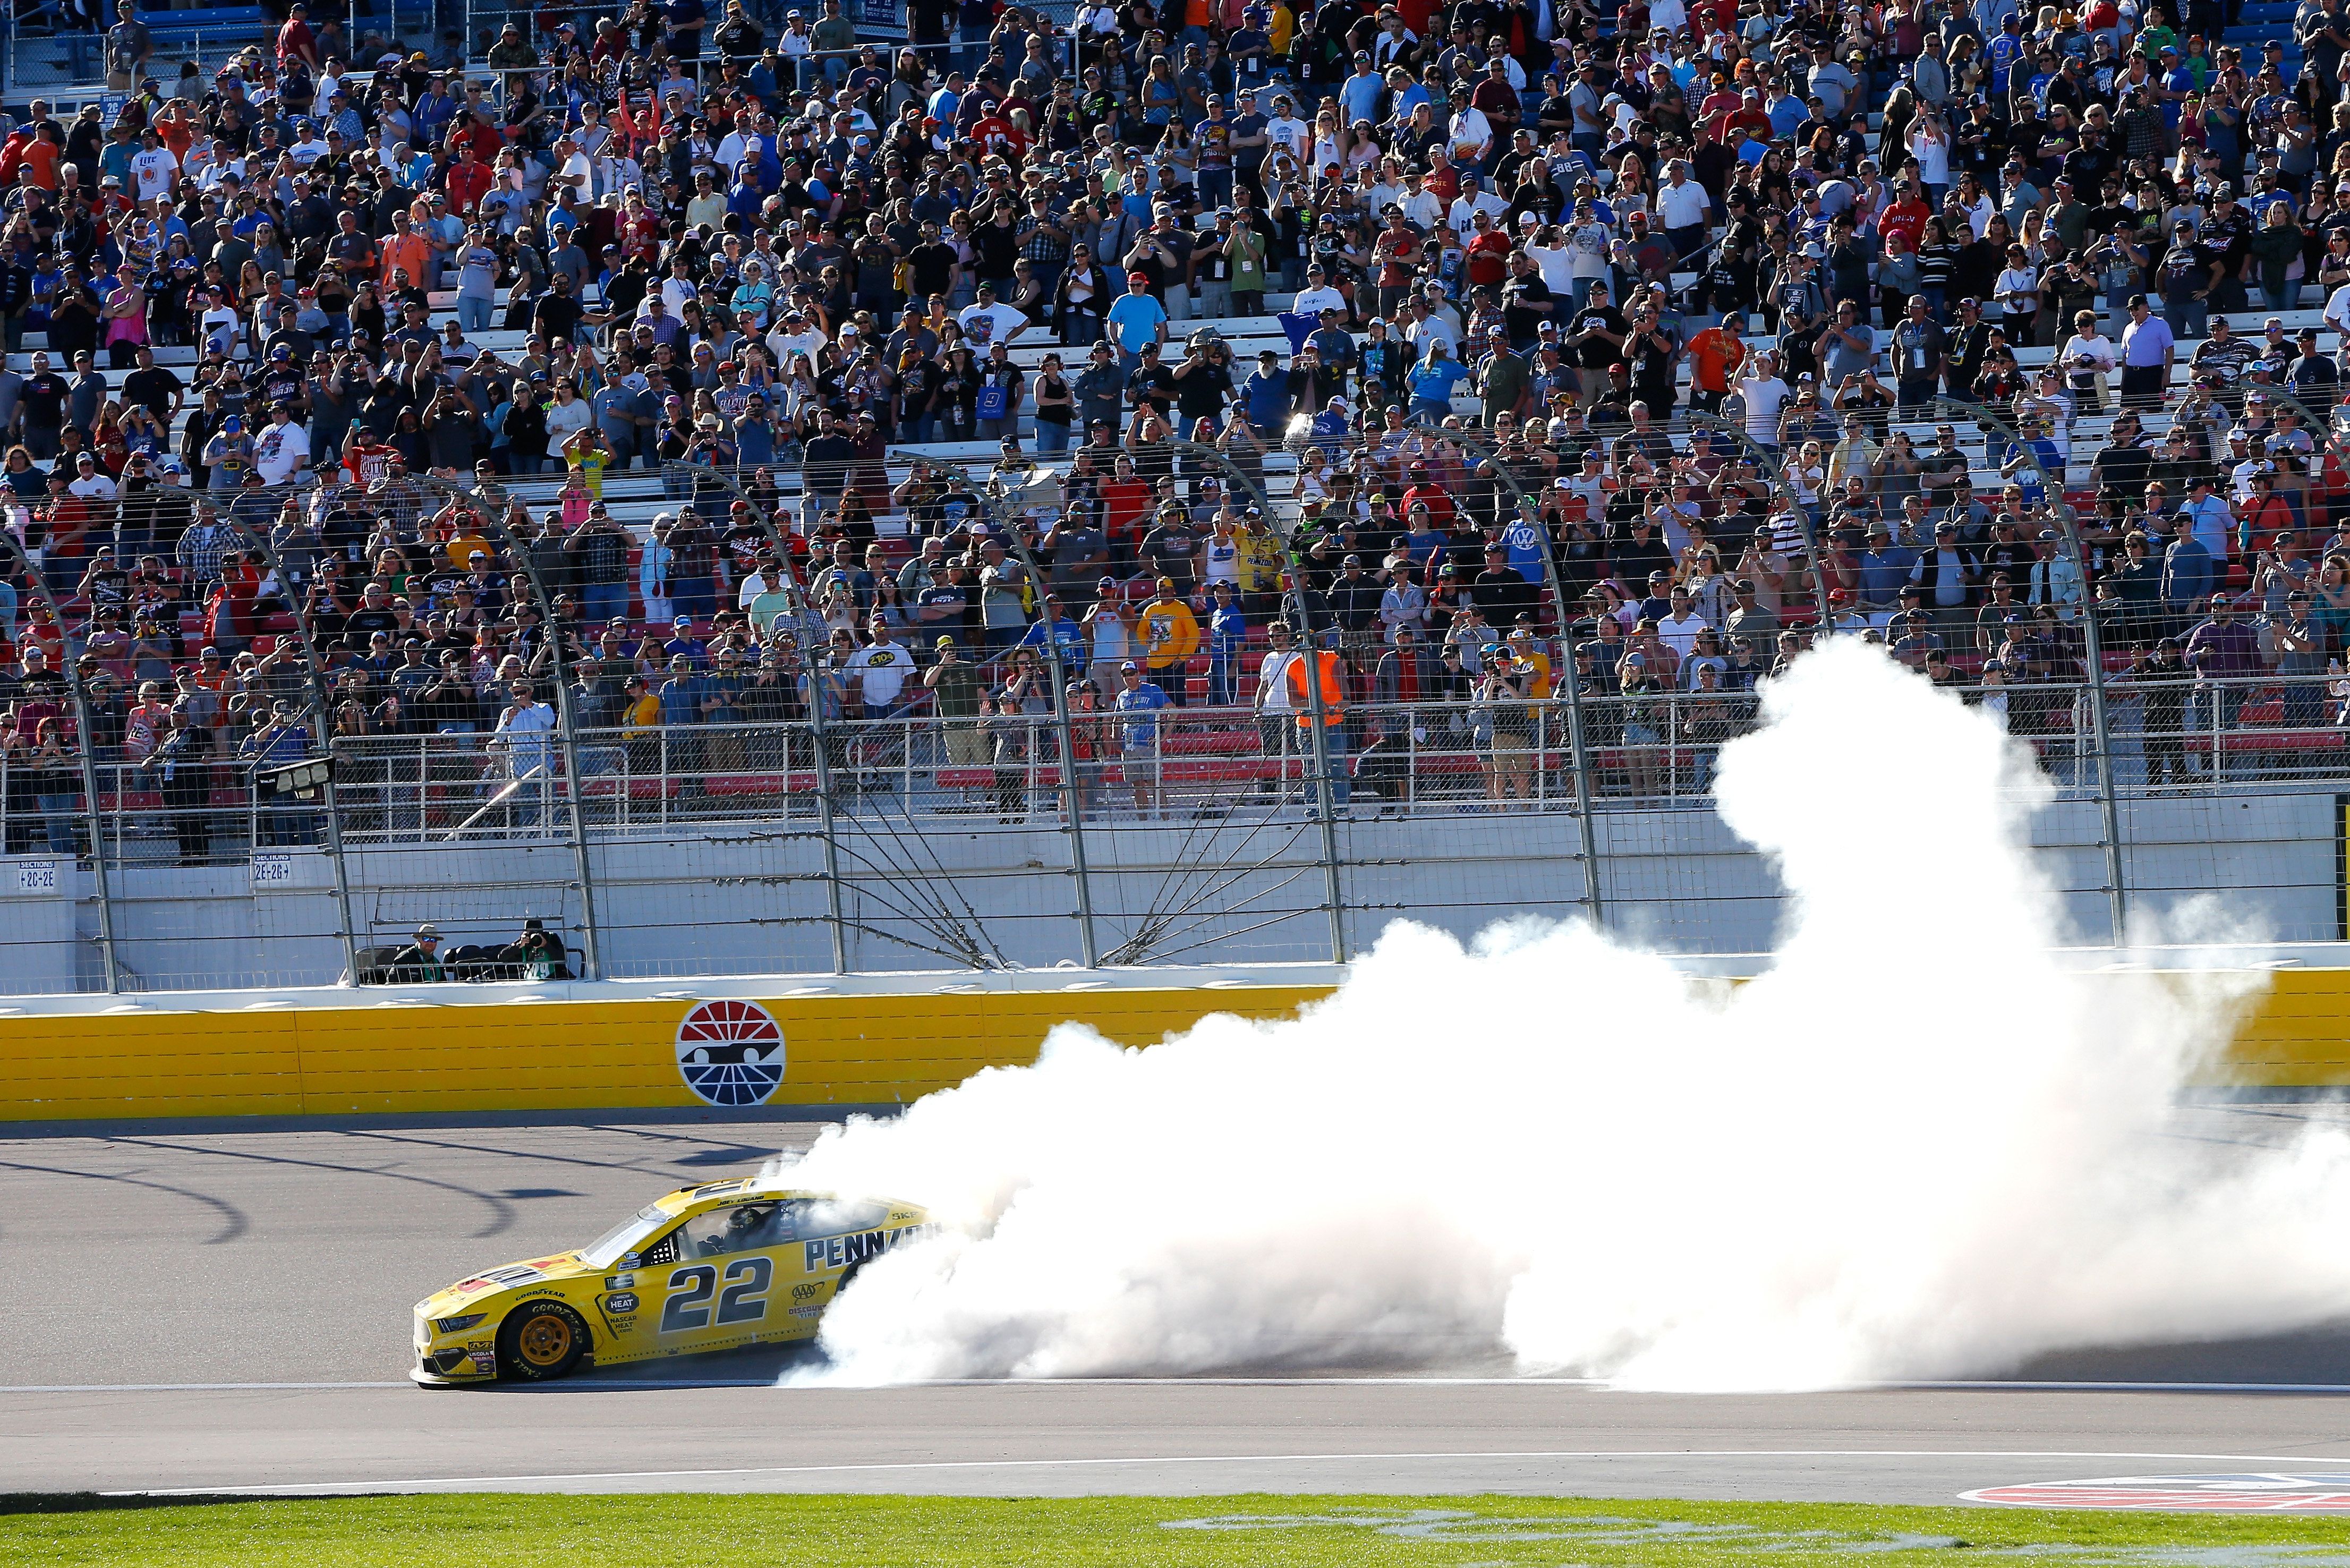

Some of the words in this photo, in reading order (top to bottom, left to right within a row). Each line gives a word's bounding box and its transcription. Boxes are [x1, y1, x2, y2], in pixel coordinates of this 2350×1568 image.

[1994, 39, 2012, 59] 9
[2100, 79, 2113, 92] 88
[139, 155, 157, 166] Lite
[1556, 161, 1574, 174] 88
[1892, 215, 1915, 224] UNLV
[2143, 214, 2158, 224] 48
[2205, 237, 2233, 249] Bud
[984, 393, 1000, 406] 9
[1317, 425, 1331, 434] One
[136, 444, 150, 454] 42
[362, 462, 382, 474] OUTT
[744, 536, 760, 548] 41
[1247, 557, 1273, 567] PENNZOIL
[110, 578, 125, 587] 10
[870, 653, 893, 665] Z104
[28, 871, 54, 884] 2C-2E
[256, 864, 283, 879] 2E-2G
[892, 1211, 918, 1221] SKF
[515, 1288, 566, 1301] GOODYEAR
[659, 1256, 774, 1334] 22
[610, 1299, 634, 1308] HEAT
[610, 1315, 637, 1324] NASCAR
